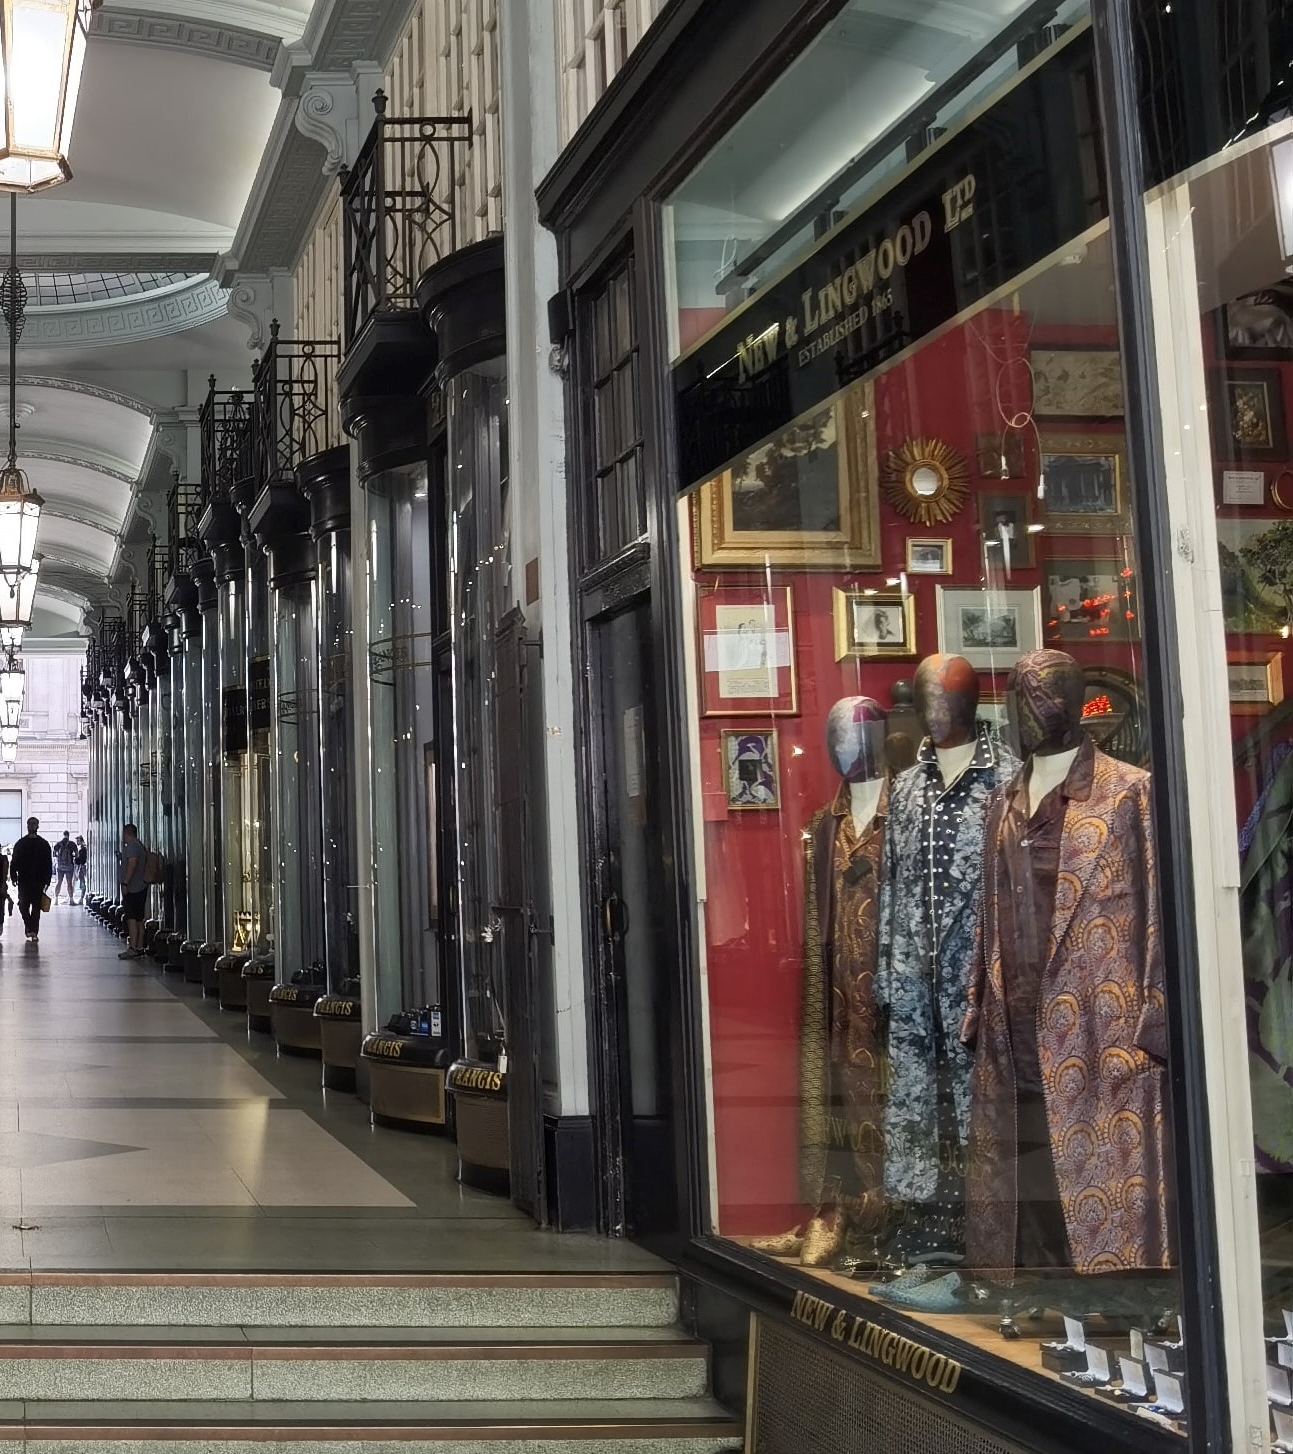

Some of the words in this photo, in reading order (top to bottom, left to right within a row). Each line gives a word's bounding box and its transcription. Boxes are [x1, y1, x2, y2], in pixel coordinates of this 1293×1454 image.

[737, 325, 779, 384] NEW
[785, 315, 798, 349] &
[801, 211, 932, 336] LINGWOOD
[798, 305, 869, 367] ESTABLISHED
[790, 1290, 835, 1332] NEW
[830, 1309, 847, 1342] &
[847, 1316, 961, 1394] LINGWOOD
